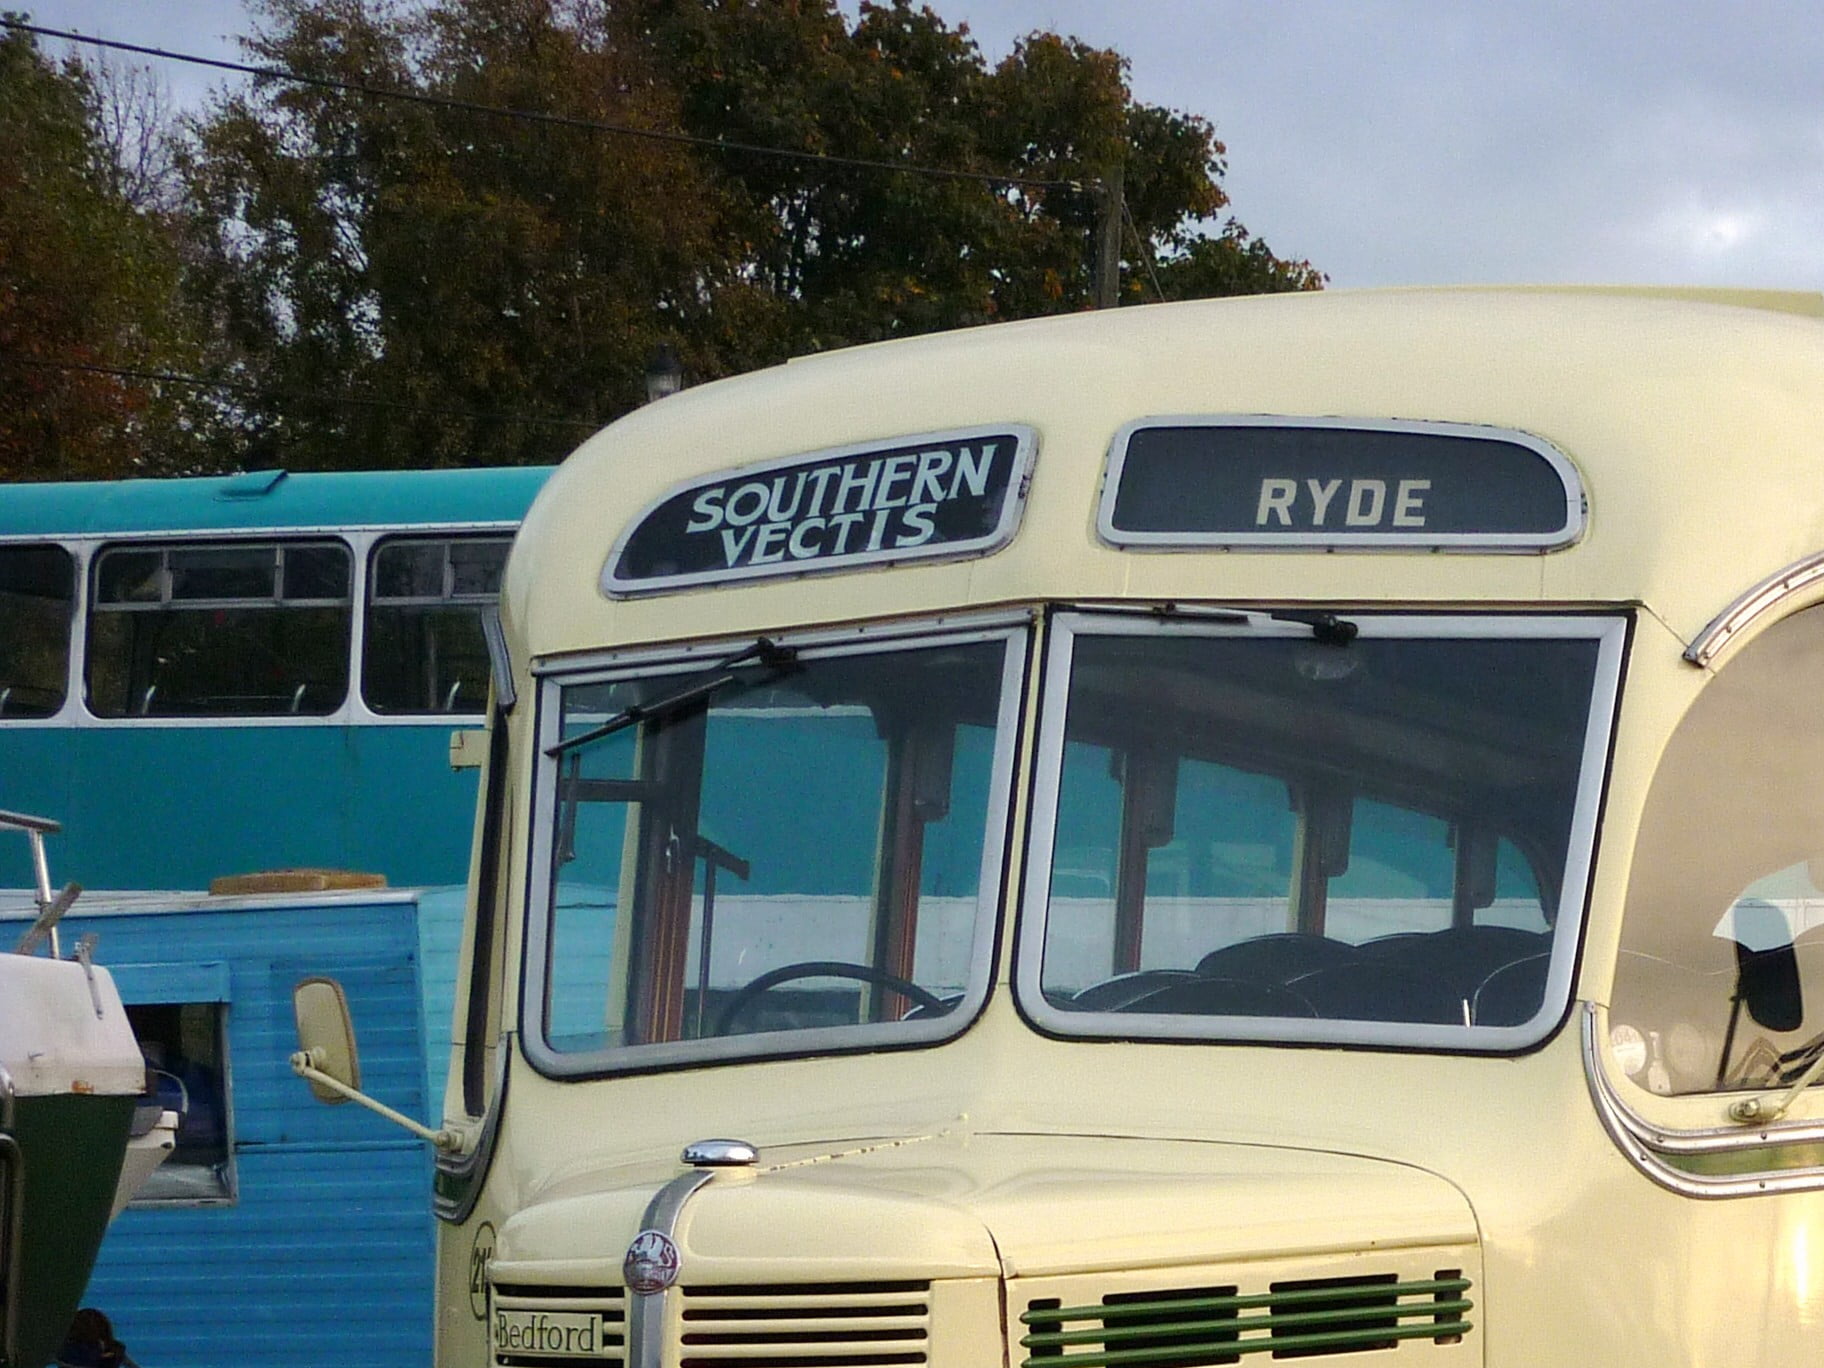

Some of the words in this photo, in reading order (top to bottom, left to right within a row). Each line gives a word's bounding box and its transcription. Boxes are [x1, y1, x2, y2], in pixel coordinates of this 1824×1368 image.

[686, 444, 998, 533] SOUTHERN
[1255, 478, 1432, 527] RYDE
[721, 503, 938, 568] VECTIS
[472, 1247, 492, 1293] 21
[499, 1314, 596, 1352] Bedford
